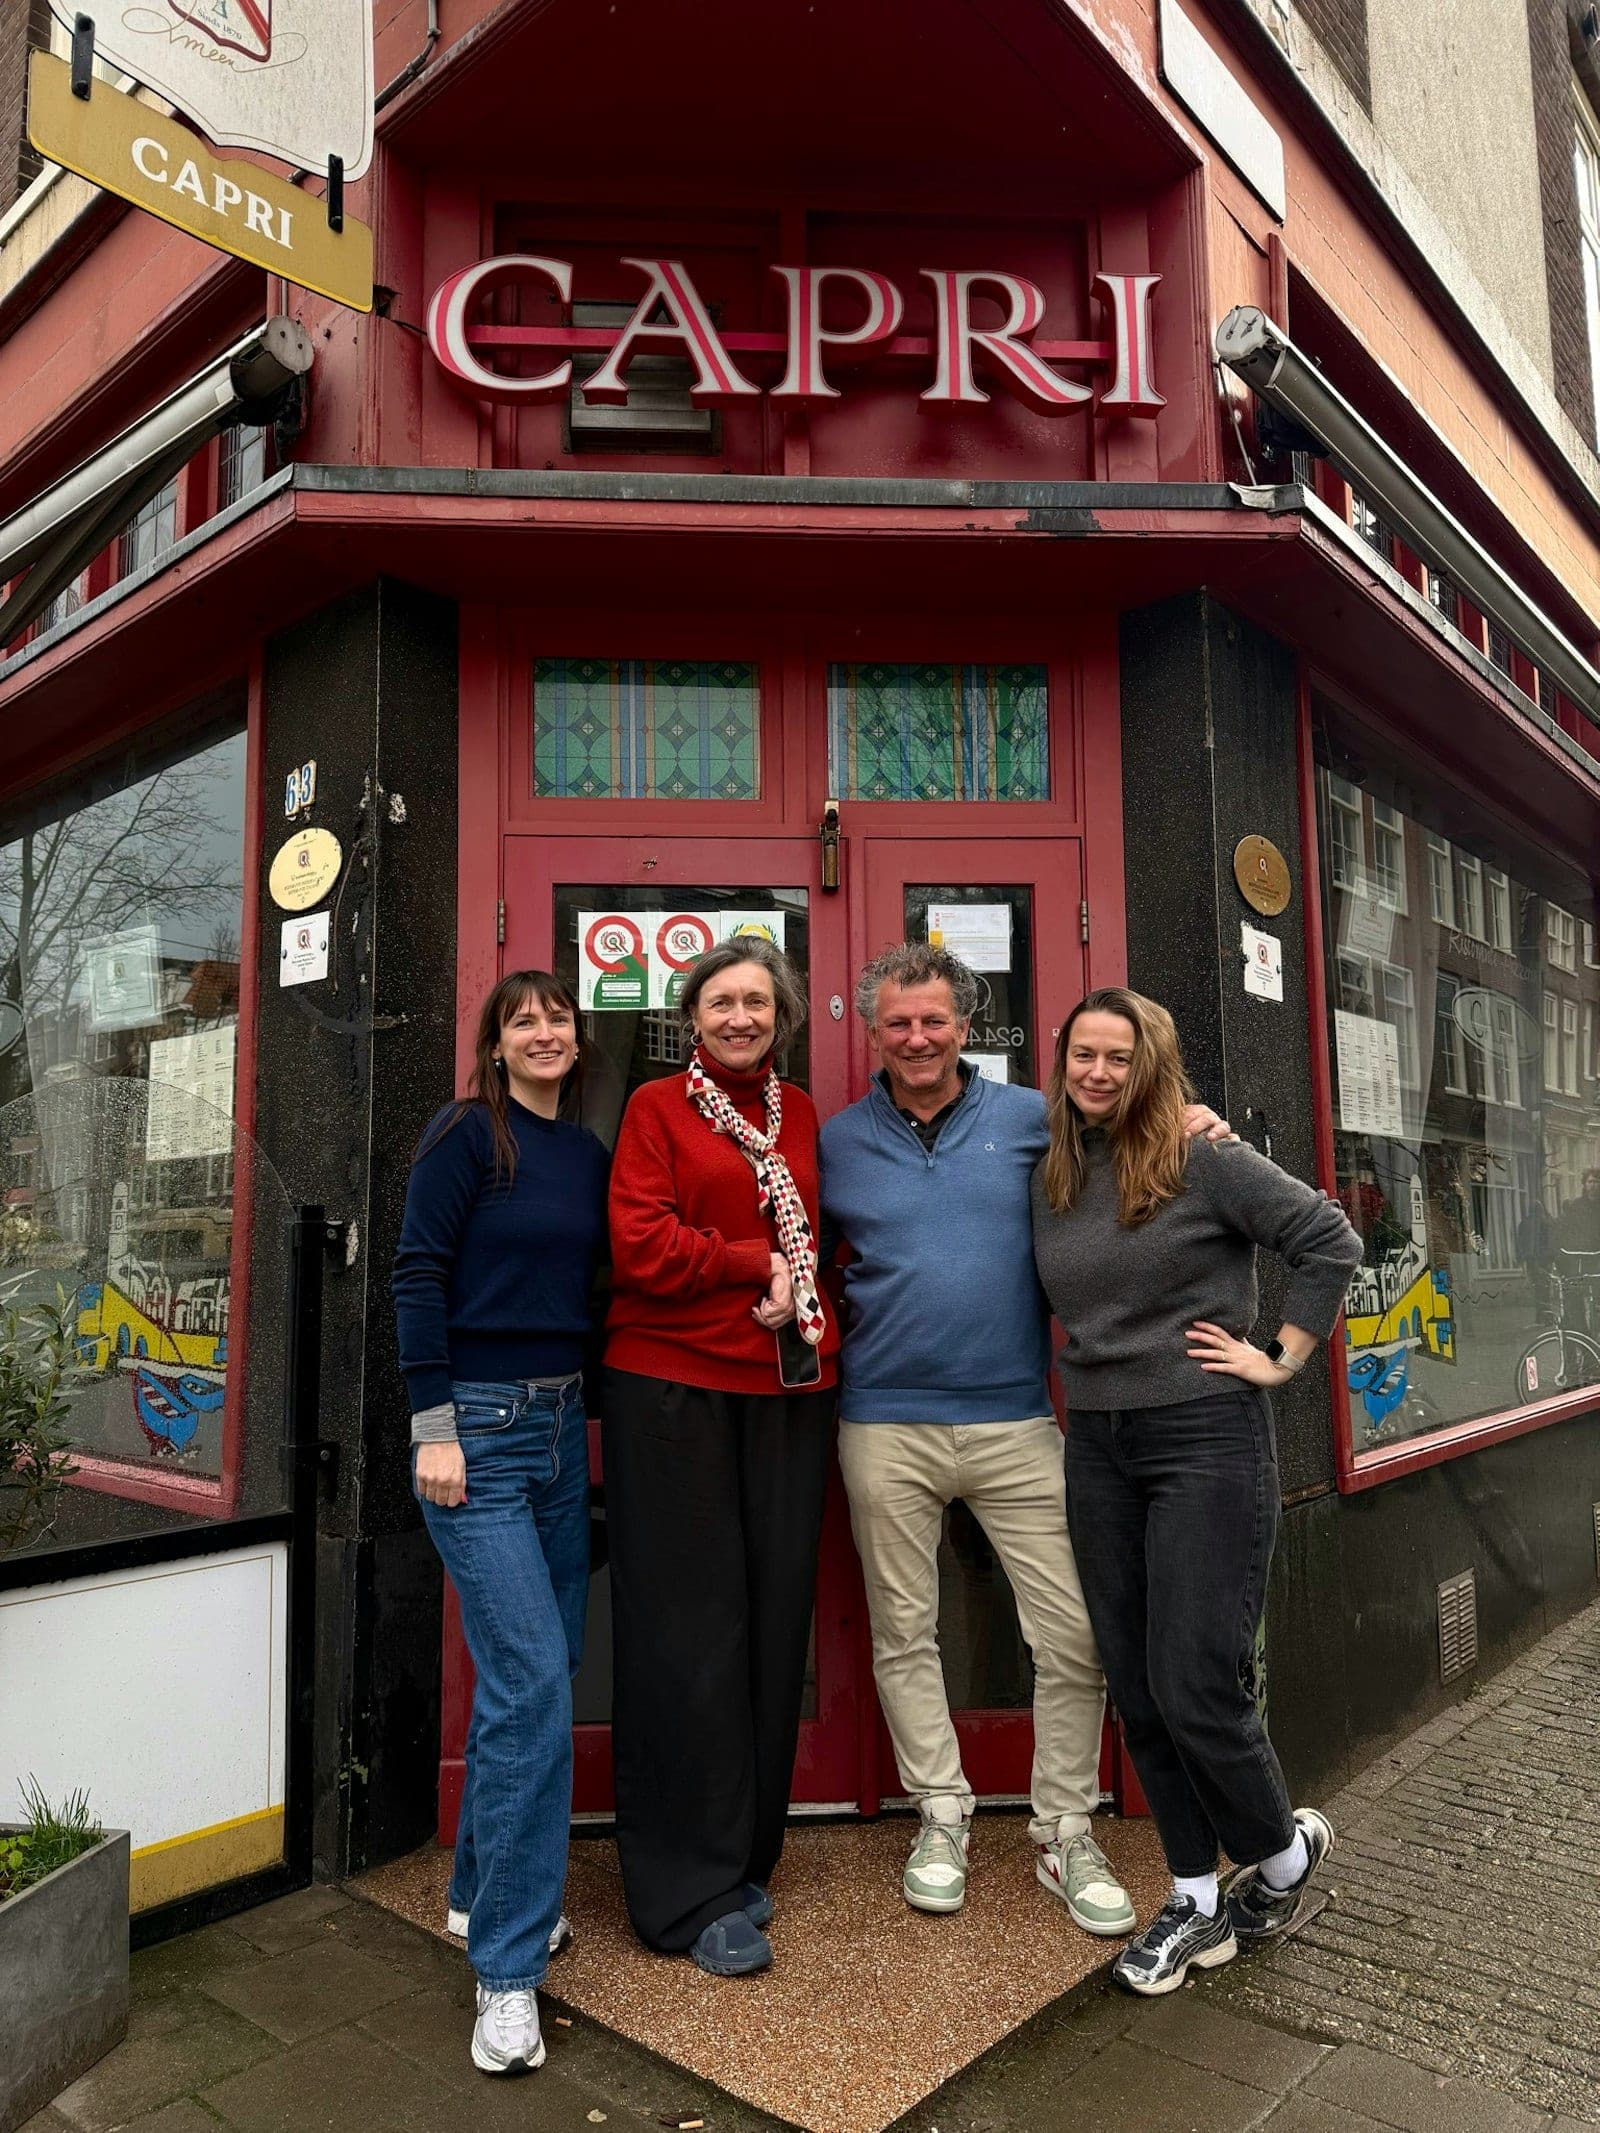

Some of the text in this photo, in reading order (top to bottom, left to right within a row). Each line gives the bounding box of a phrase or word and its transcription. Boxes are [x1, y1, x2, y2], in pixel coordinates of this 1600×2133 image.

[130, 136, 295, 250] CAPRI
[426, 253, 1168, 410] CAPRI
[287, 762, 313, 813] 63
